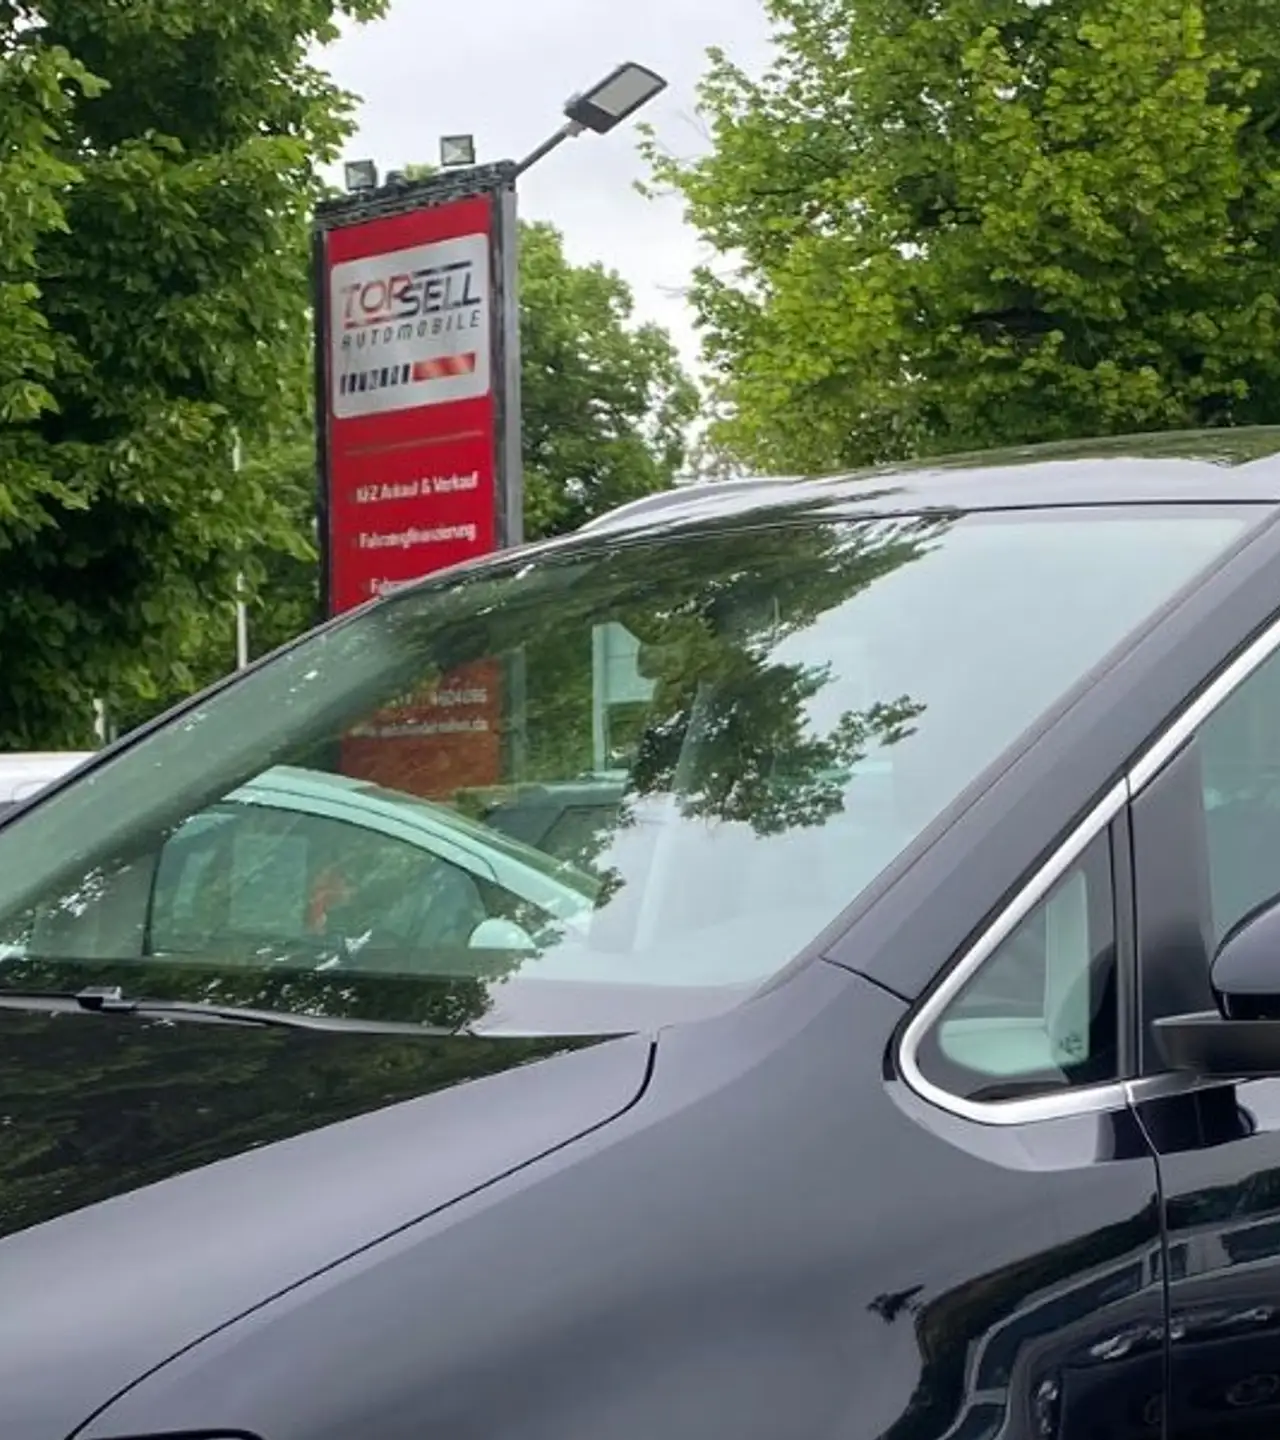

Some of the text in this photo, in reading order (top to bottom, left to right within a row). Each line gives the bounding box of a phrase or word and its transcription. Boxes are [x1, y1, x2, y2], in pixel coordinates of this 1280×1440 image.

[340, 268, 481, 323] TOPSELL
[341, 310, 481, 349] AUTOMOBILE
[421, 477, 432, 495] &
[433, 470, 479, 493] Verkauf
